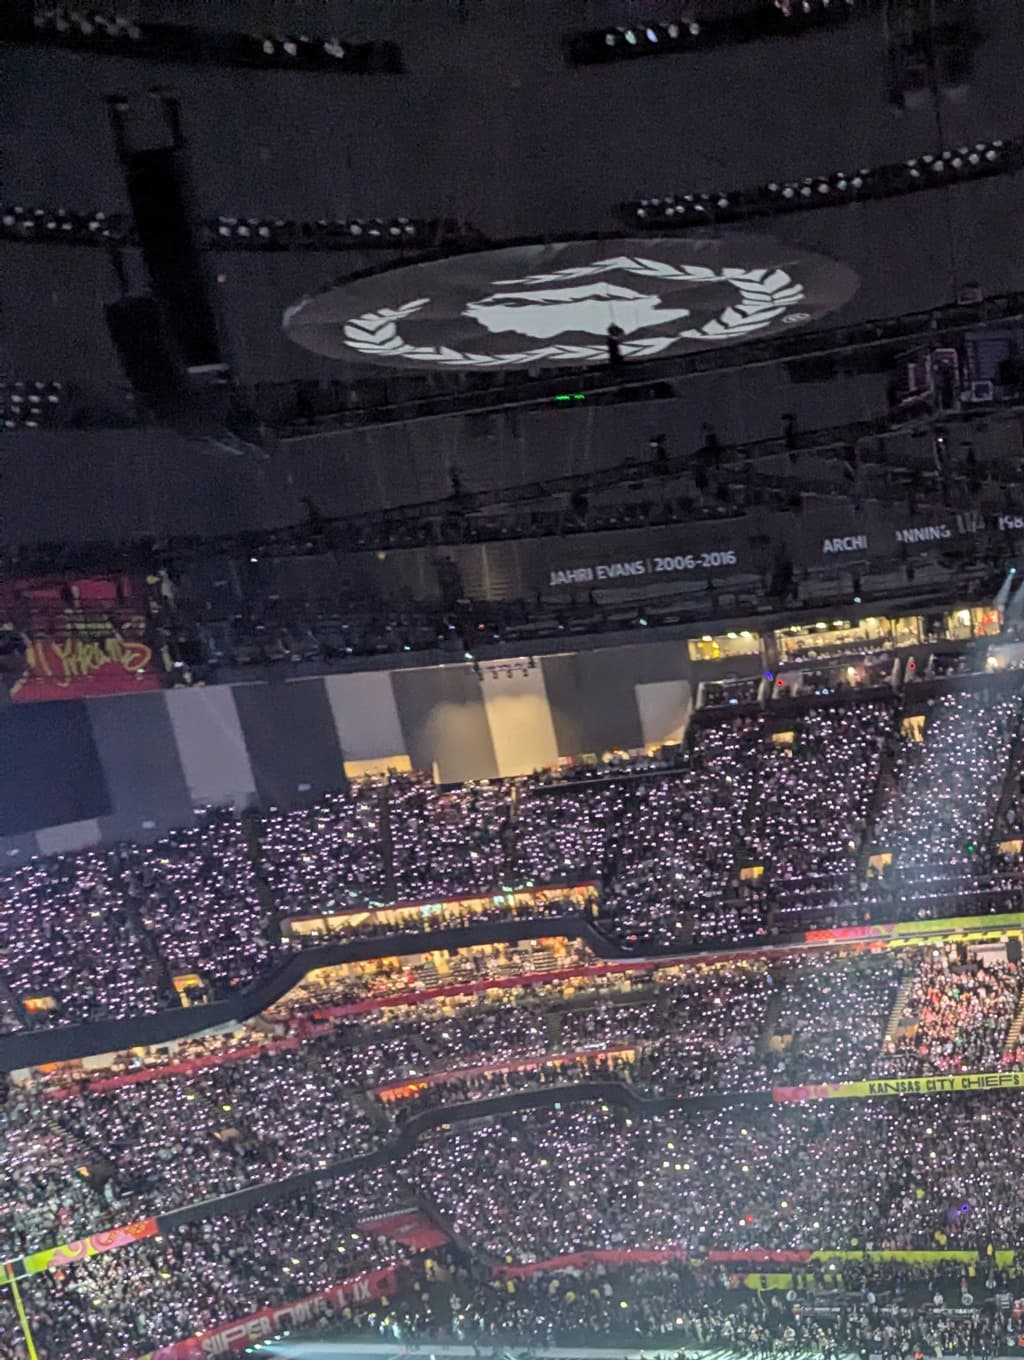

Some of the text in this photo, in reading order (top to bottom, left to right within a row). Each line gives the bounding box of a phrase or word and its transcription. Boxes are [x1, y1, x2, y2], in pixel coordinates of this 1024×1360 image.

[823, 535, 868, 553] ARCHI
[549, 550, 737, 586] JAHRI EVANS 2006-2016
[868, 1074, 1020, 1094] KANSAS CITY CHIEFS
